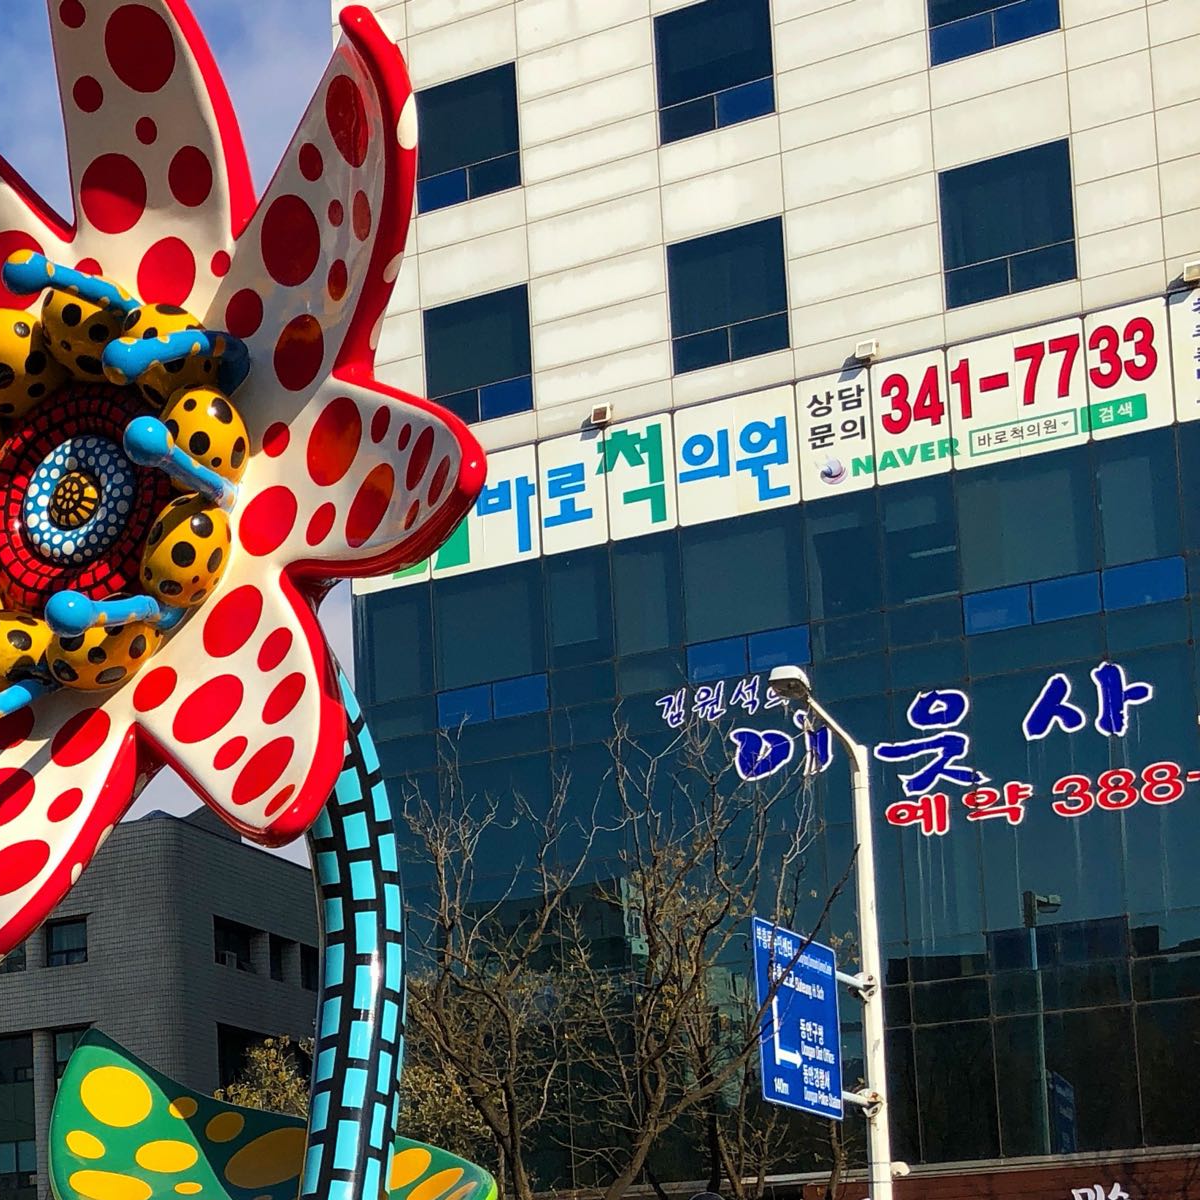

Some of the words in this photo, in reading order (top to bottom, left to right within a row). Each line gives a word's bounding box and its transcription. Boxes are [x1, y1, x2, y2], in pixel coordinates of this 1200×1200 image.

[881, 316, 1158, 435] 341-7733
[806, 384, 865, 418] 상담
[1098, 401, 1135, 423] 검색
[807, 415, 867, 450] 문의
[978, 419, 1059, 448] 바로척의원
[851, 437, 961, 477] NAVER
[476, 416, 791, 553] 바로척의원
[885, 781, 1033, 836] 예약
[800, 1018, 824, 1046] 동안구청
[803, 1064, 831, 1092] 동안경찰서
